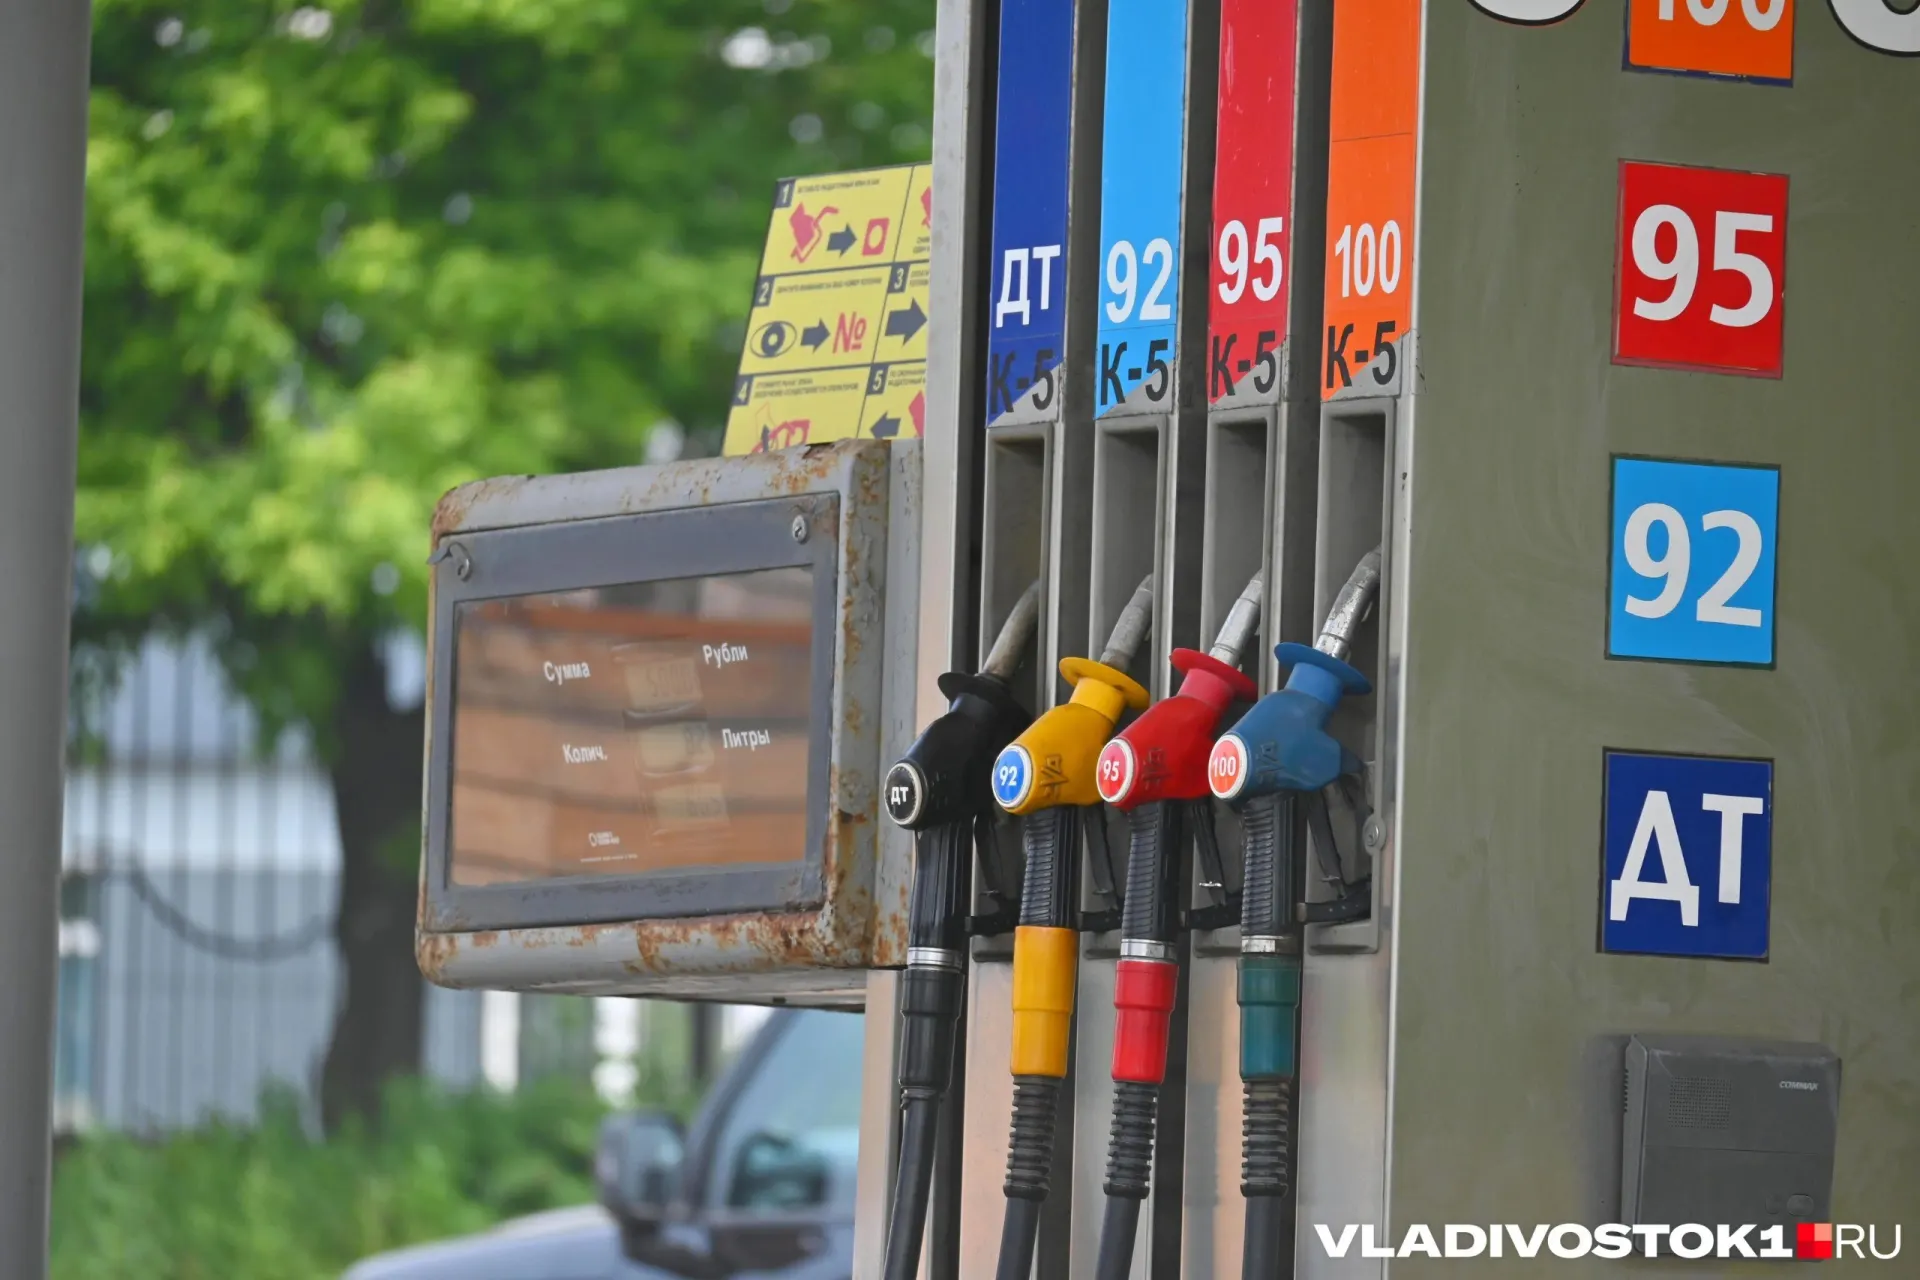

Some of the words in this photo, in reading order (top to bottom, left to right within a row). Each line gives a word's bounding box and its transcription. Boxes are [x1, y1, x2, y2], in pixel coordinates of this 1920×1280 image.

[783, 183, 790, 204] 1
[894, 267, 905, 290] 3
[1106, 238, 1173, 323] 92
[1218, 216, 1283, 304] 95
[1335, 220, 1401, 298] 100
[1631, 204, 1774, 328] 95
[759, 282, 770, 303] 2
[995, 244, 1061, 328] ДТ
[832, 311, 867, 354] №
[1100, 339, 1169, 406] К-5
[1211, 330, 1277, 398] К-5
[1326, 320, 1397, 390] К-5
[737, 381, 748, 402] 4
[872, 370, 884, 391] 5
[989, 348, 1055, 415] К-5
[1623, 502, 1763, 628] 92
[543, 660, 591, 686] Сумма
[702, 641, 749, 669] Рубли
[1000, 765, 1018, 787] 92
[1103, 759, 1121, 782] 95
[1212, 756, 1237, 778] 100
[891, 786, 909, 806] ДТ
[1609, 789, 1764, 928] ДТ
